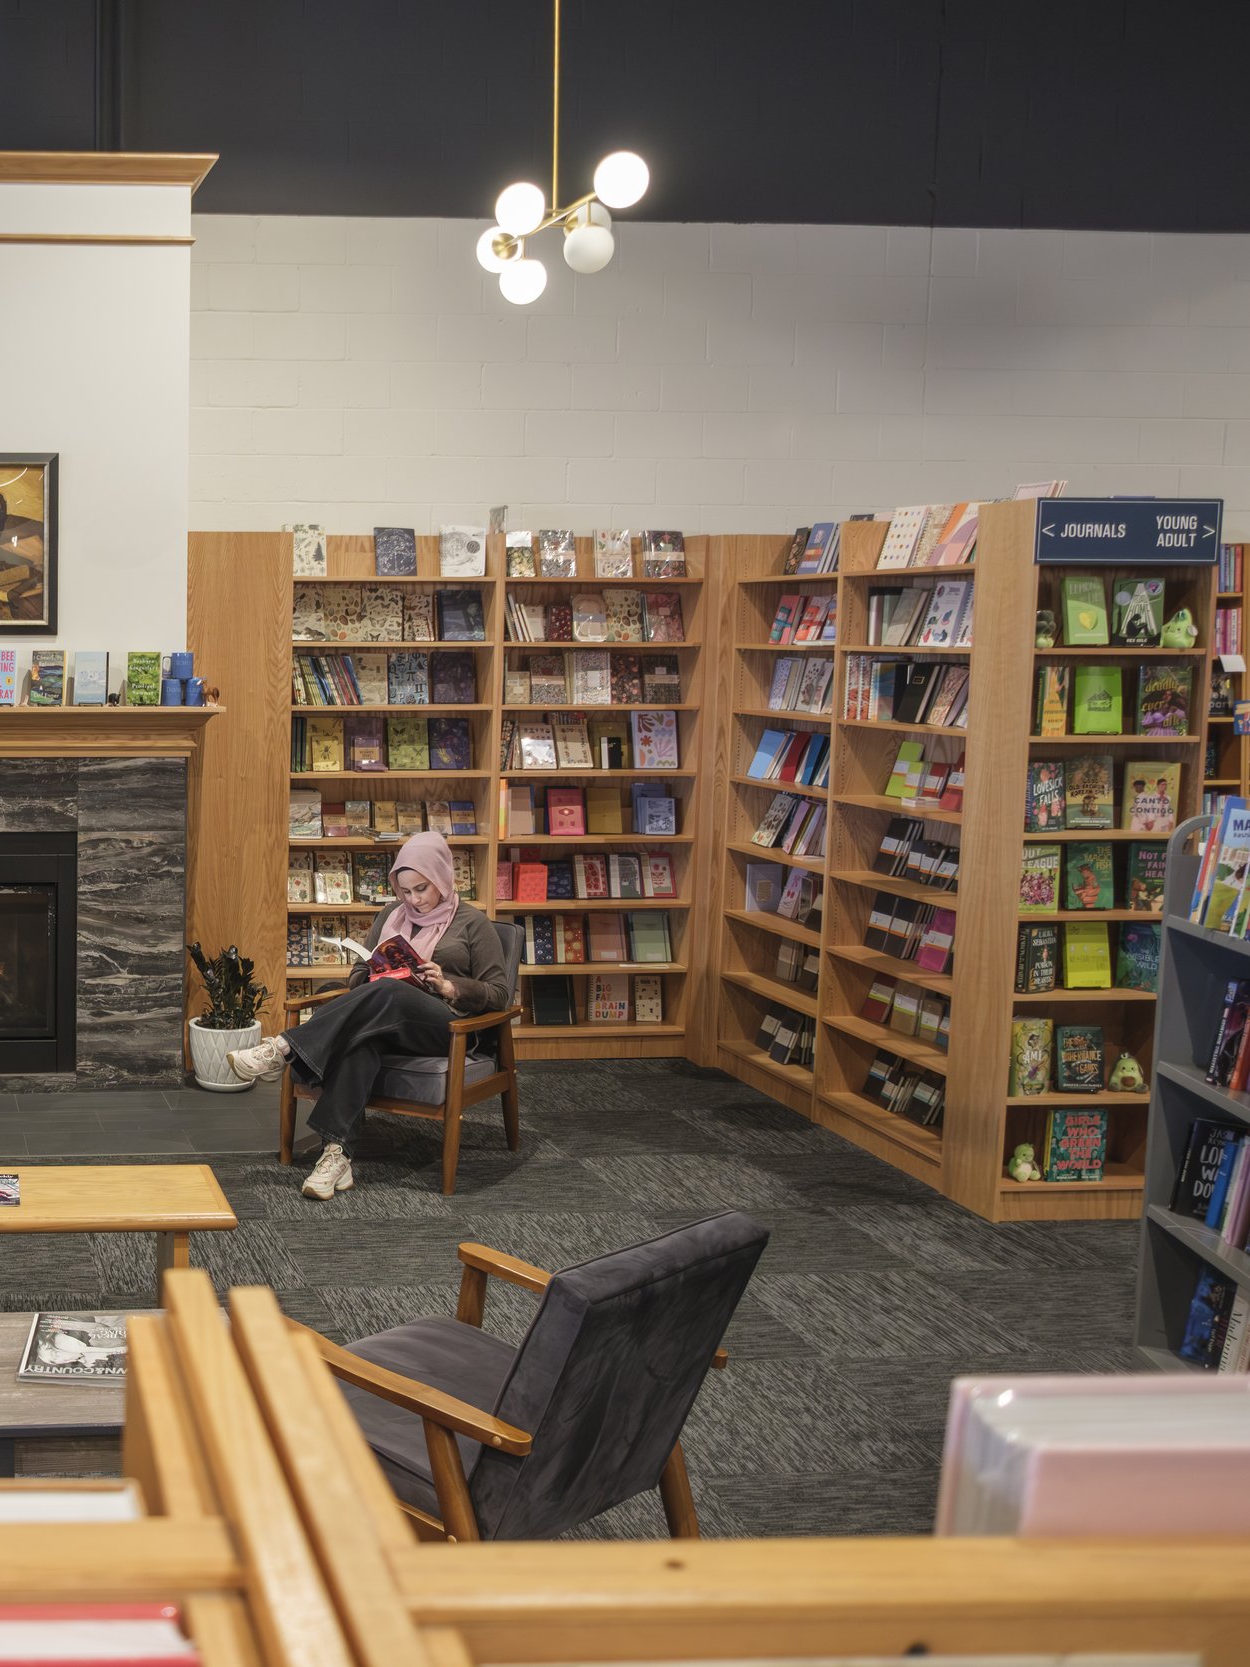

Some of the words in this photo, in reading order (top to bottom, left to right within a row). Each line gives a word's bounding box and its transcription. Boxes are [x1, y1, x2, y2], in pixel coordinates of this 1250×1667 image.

[1155, 515, 1198, 530] YOUNG
[1060, 523, 1126, 538] JOURNALS
[1156, 533, 1197, 547] ADULT
[1, 651, 14, 661] BEE
[1033, 776, 1063, 797] LOVESICK
[1039, 790, 1060, 805] FALLS
[1134, 797, 1170, 805] CANTO
[1129, 806, 1174, 815] CONTIGO
[1138, 850, 1159, 860] NOT
[1022, 856, 1059, 869] LEAGUE
[596, 975, 602, 983] A
[596, 993, 611, 1001] FAT
[595, 1011, 623, 1019] DUMP
[1065, 1114, 1102, 1125] GIRLS
[1067, 1126, 1098, 1136] WHO
[1059, 1137, 1101, 1147] GREEN
[1069, 1148, 1092, 1158] THE
[1057, 1159, 1102, 1170] WORLD
